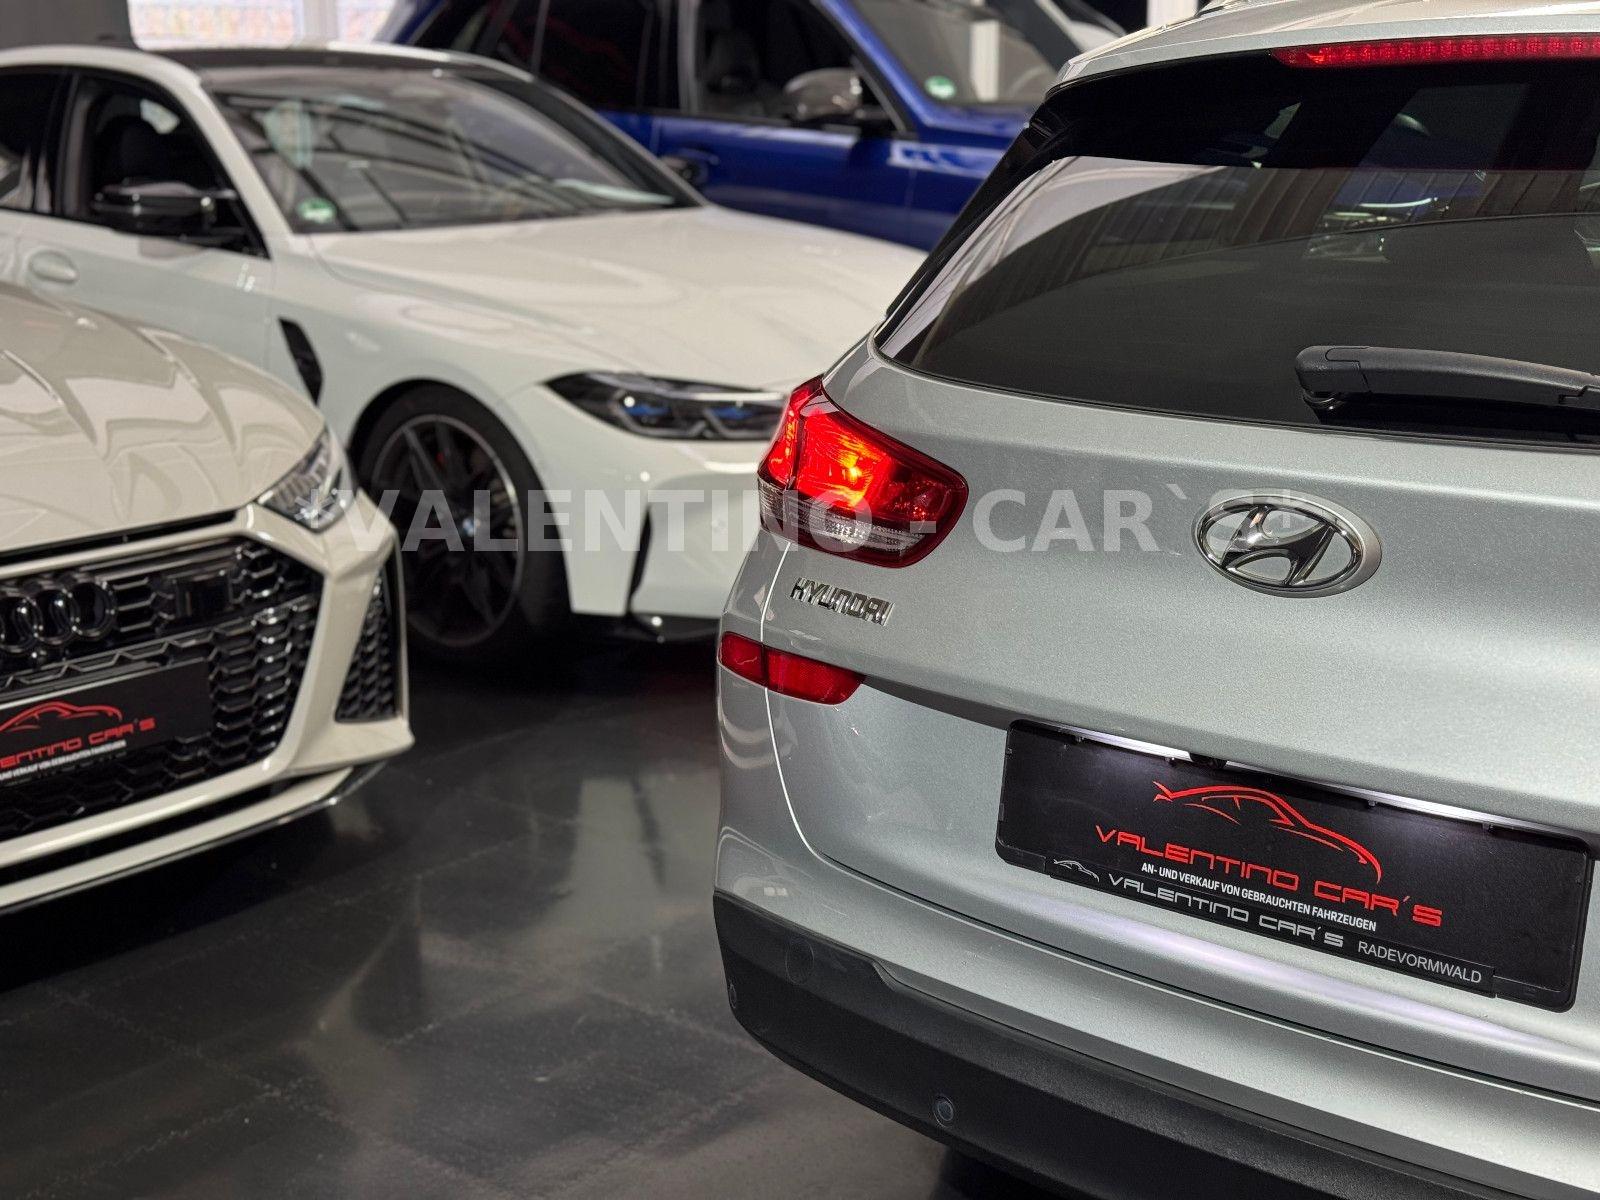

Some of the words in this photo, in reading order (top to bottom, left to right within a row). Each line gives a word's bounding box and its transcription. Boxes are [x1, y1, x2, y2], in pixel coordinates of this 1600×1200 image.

[790, 577, 895, 627] HYUNDAI
[1095, 824, 1300, 892] VALENTINO
[1108, 873, 1250, 923] VALENTINO
[1357, 940, 1483, 984] RADEVORMWALD
[1141, 862, 1158, 875] AN-
[1158, 866, 1178, 881] UND
[1179, 871, 1220, 892] VERKAUF
[1220, 882, 1241, 897] VON
[1241, 887, 1311, 915] GEBRAUCHTEN
[1311, 906, 1378, 933] FAHRZEUGEN
